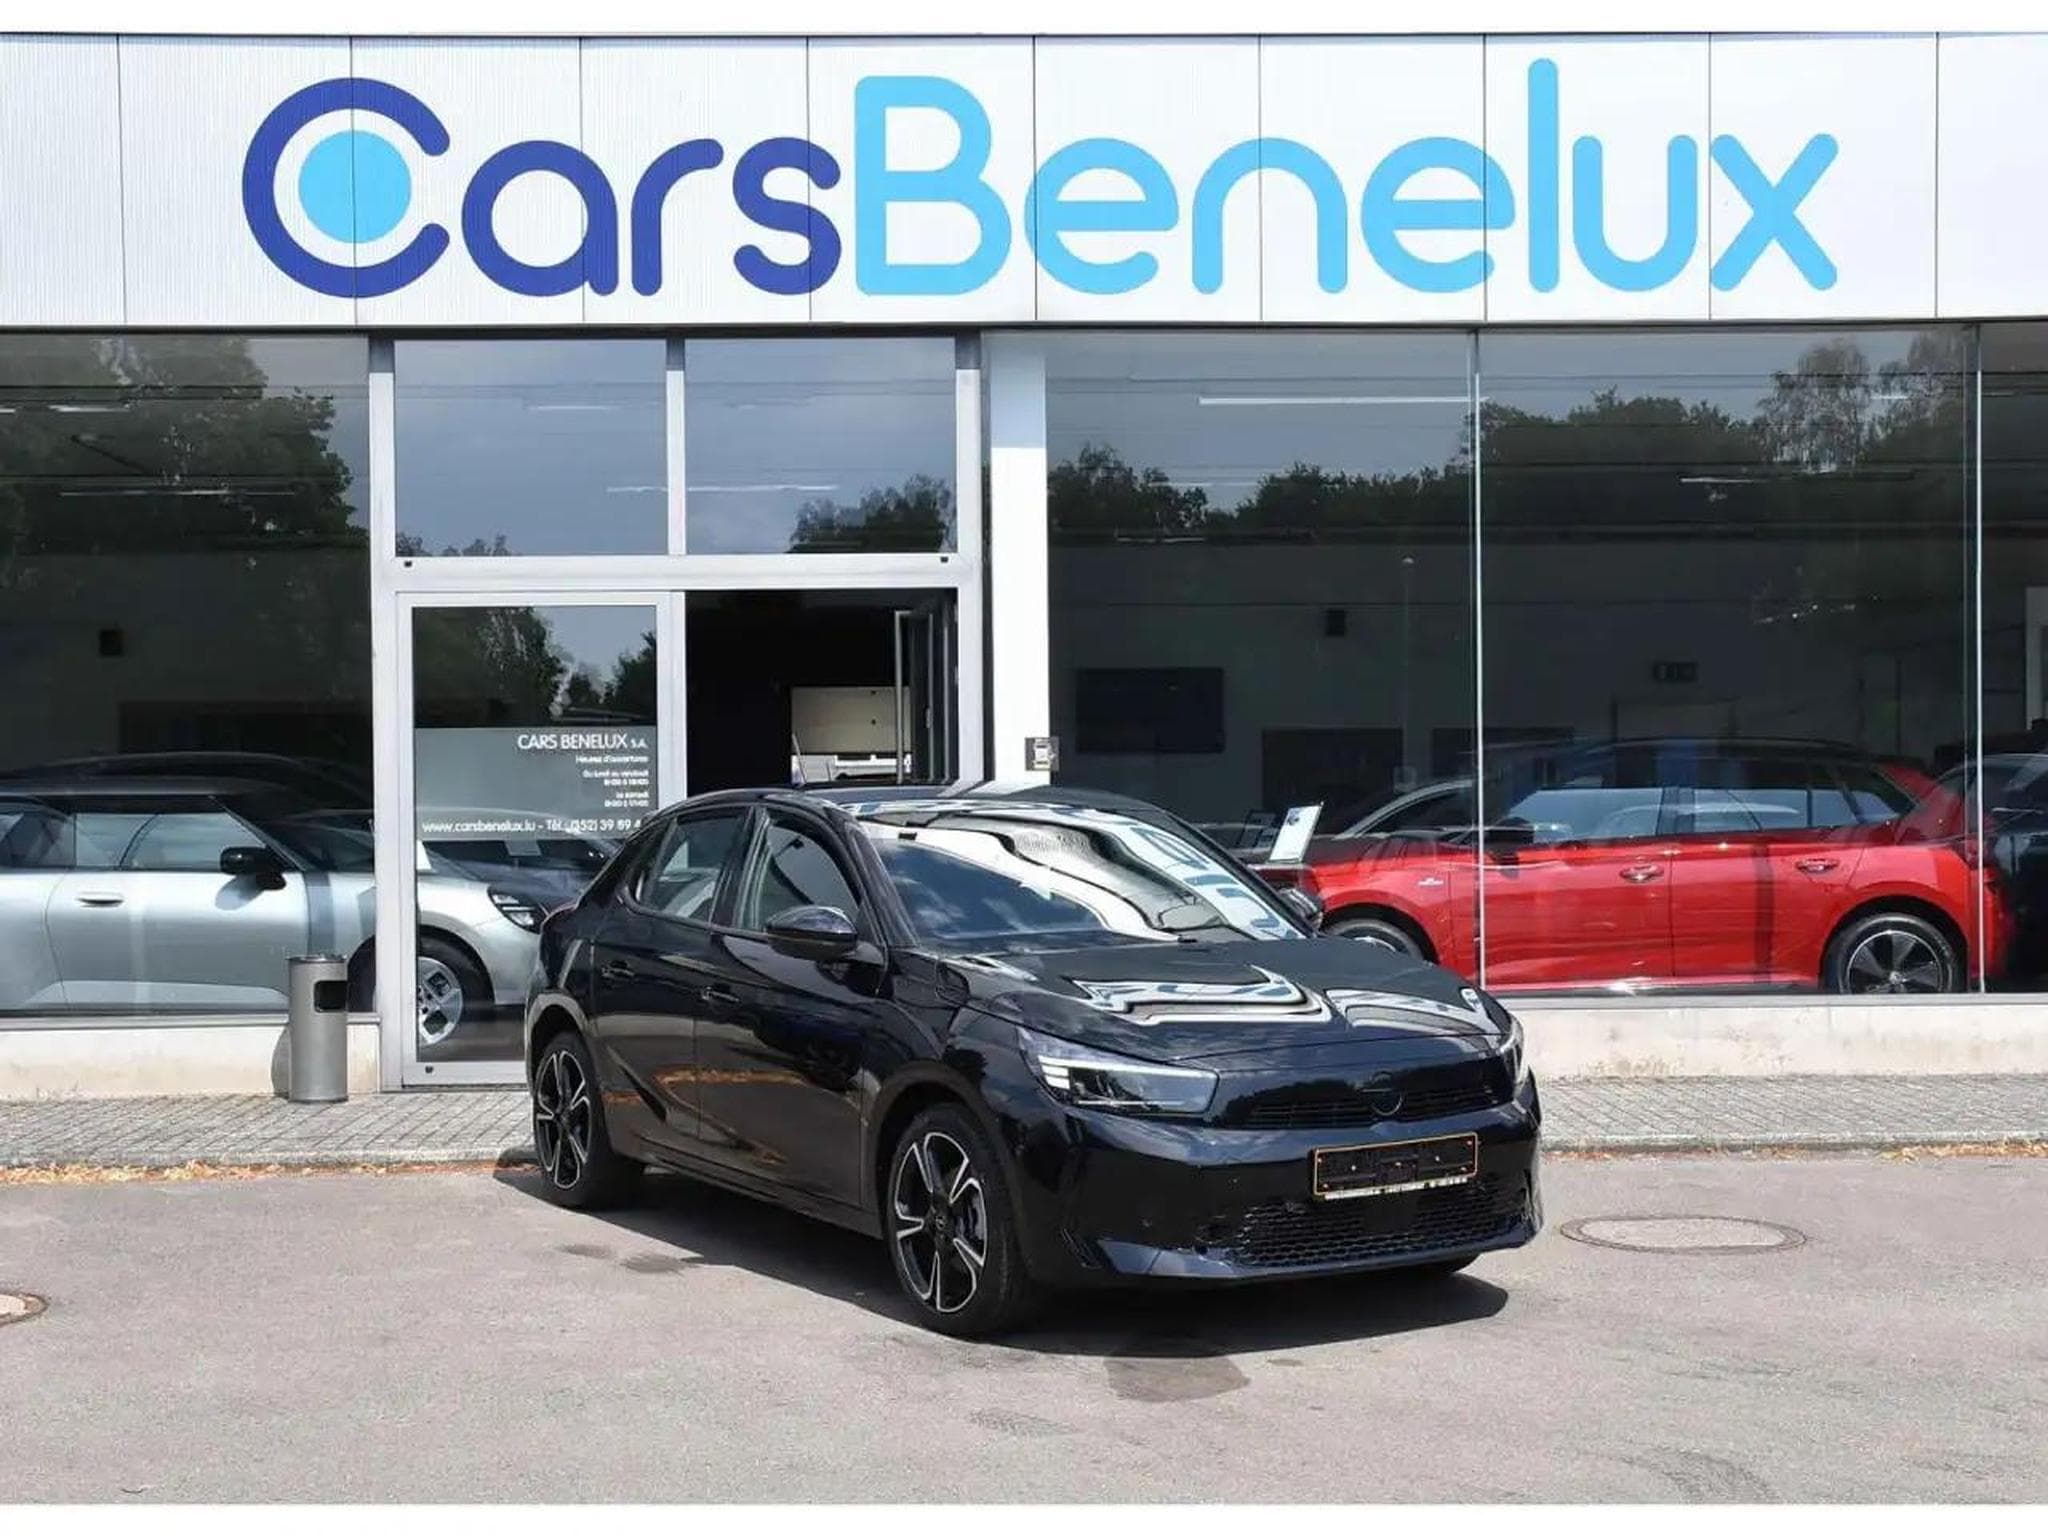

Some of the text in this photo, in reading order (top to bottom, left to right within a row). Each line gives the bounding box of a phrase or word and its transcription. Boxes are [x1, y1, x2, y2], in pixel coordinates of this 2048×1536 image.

[517, 734, 558, 749] CARS
[560, 733, 628, 749] BENELUX
[422, 819, 536, 833] www.carsbenelux.lu
[600, 819, 615, 832] 39
